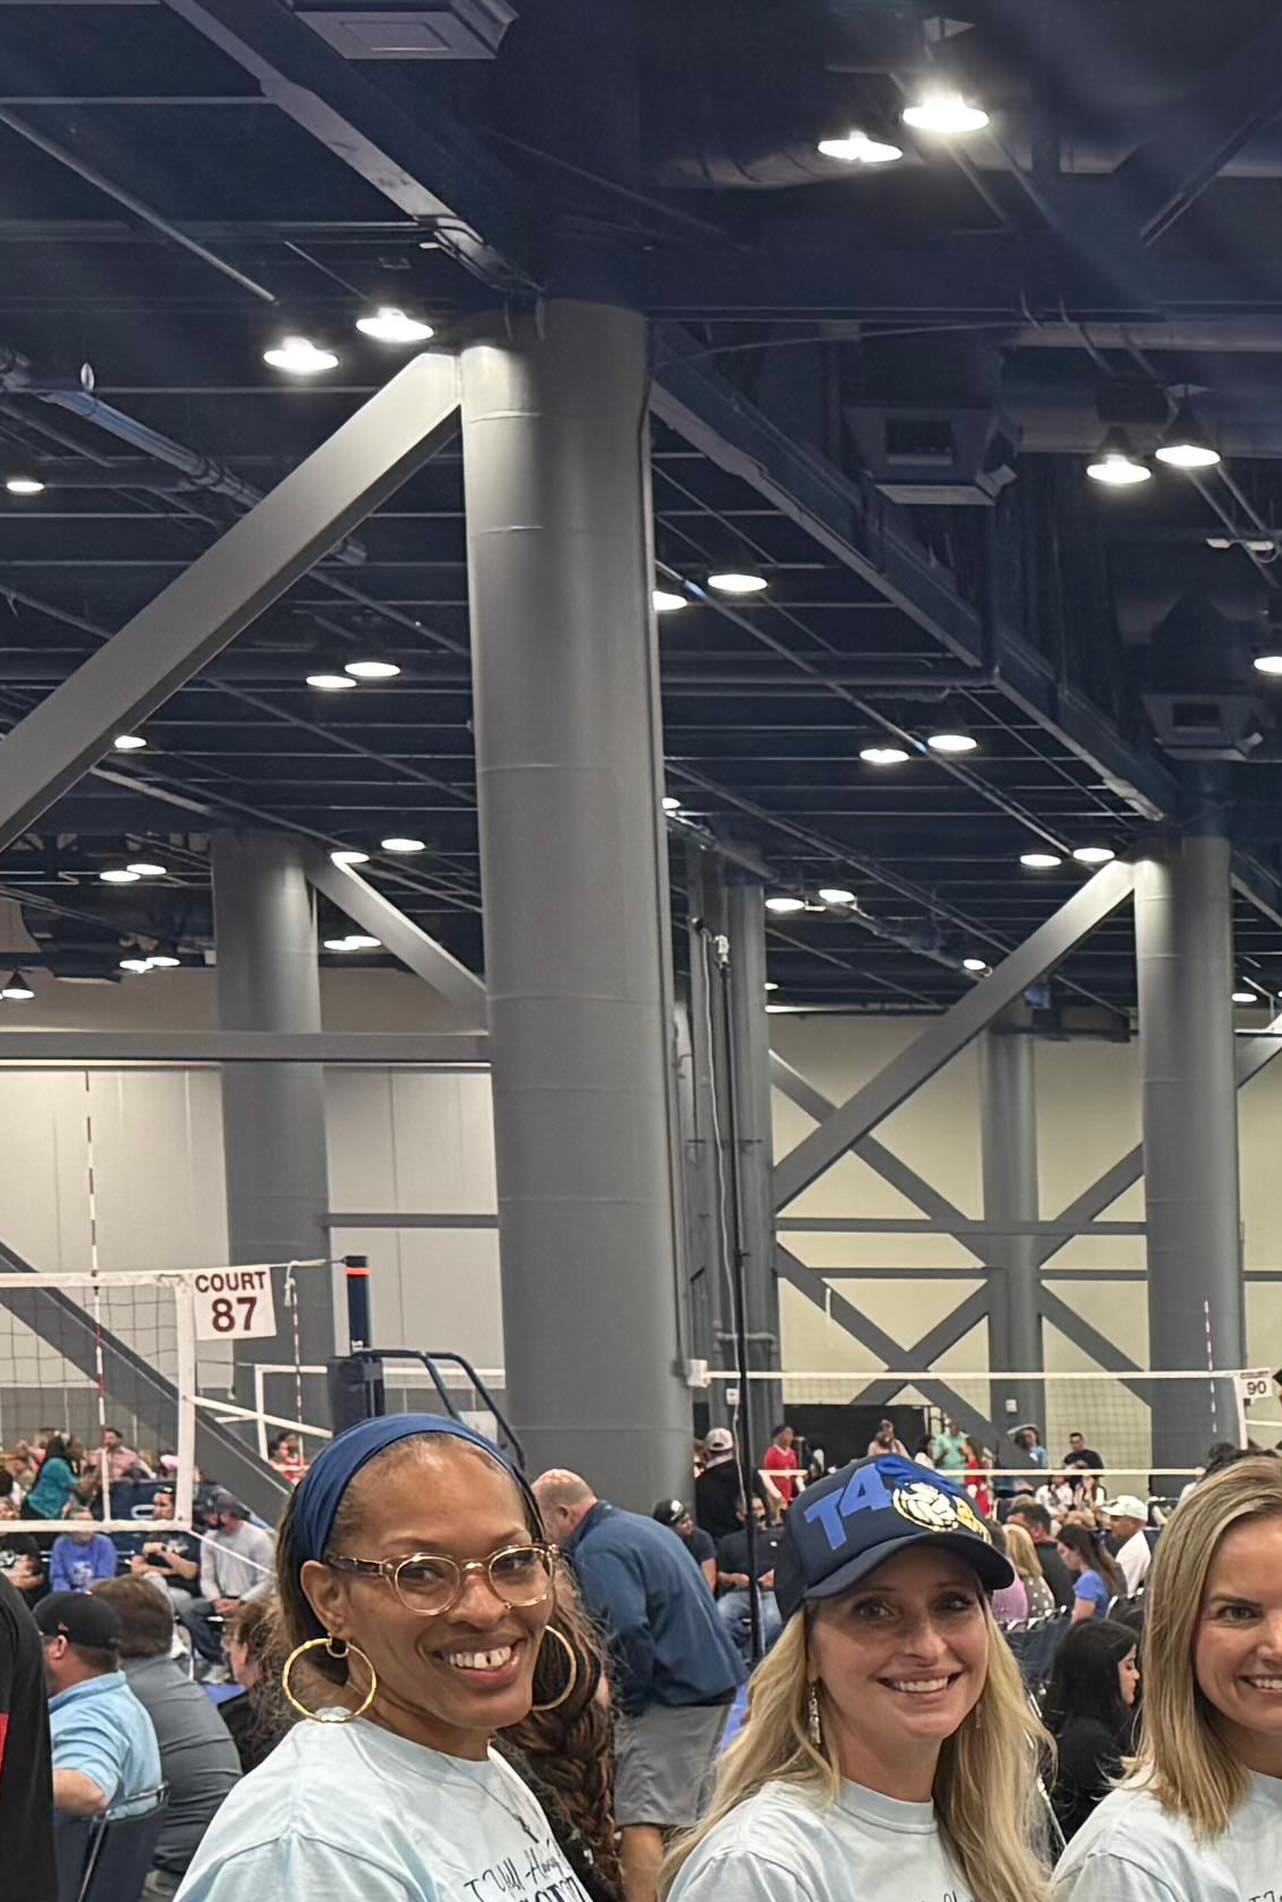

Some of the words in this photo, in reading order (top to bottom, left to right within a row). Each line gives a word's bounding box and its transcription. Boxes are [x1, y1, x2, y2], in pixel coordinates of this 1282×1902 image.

[195, 1271, 266, 1293] COURT
[212, 1297, 257, 1332] 87
[1247, 1380, 1267, 1396] 90
[804, 1462, 893, 1549] T4
